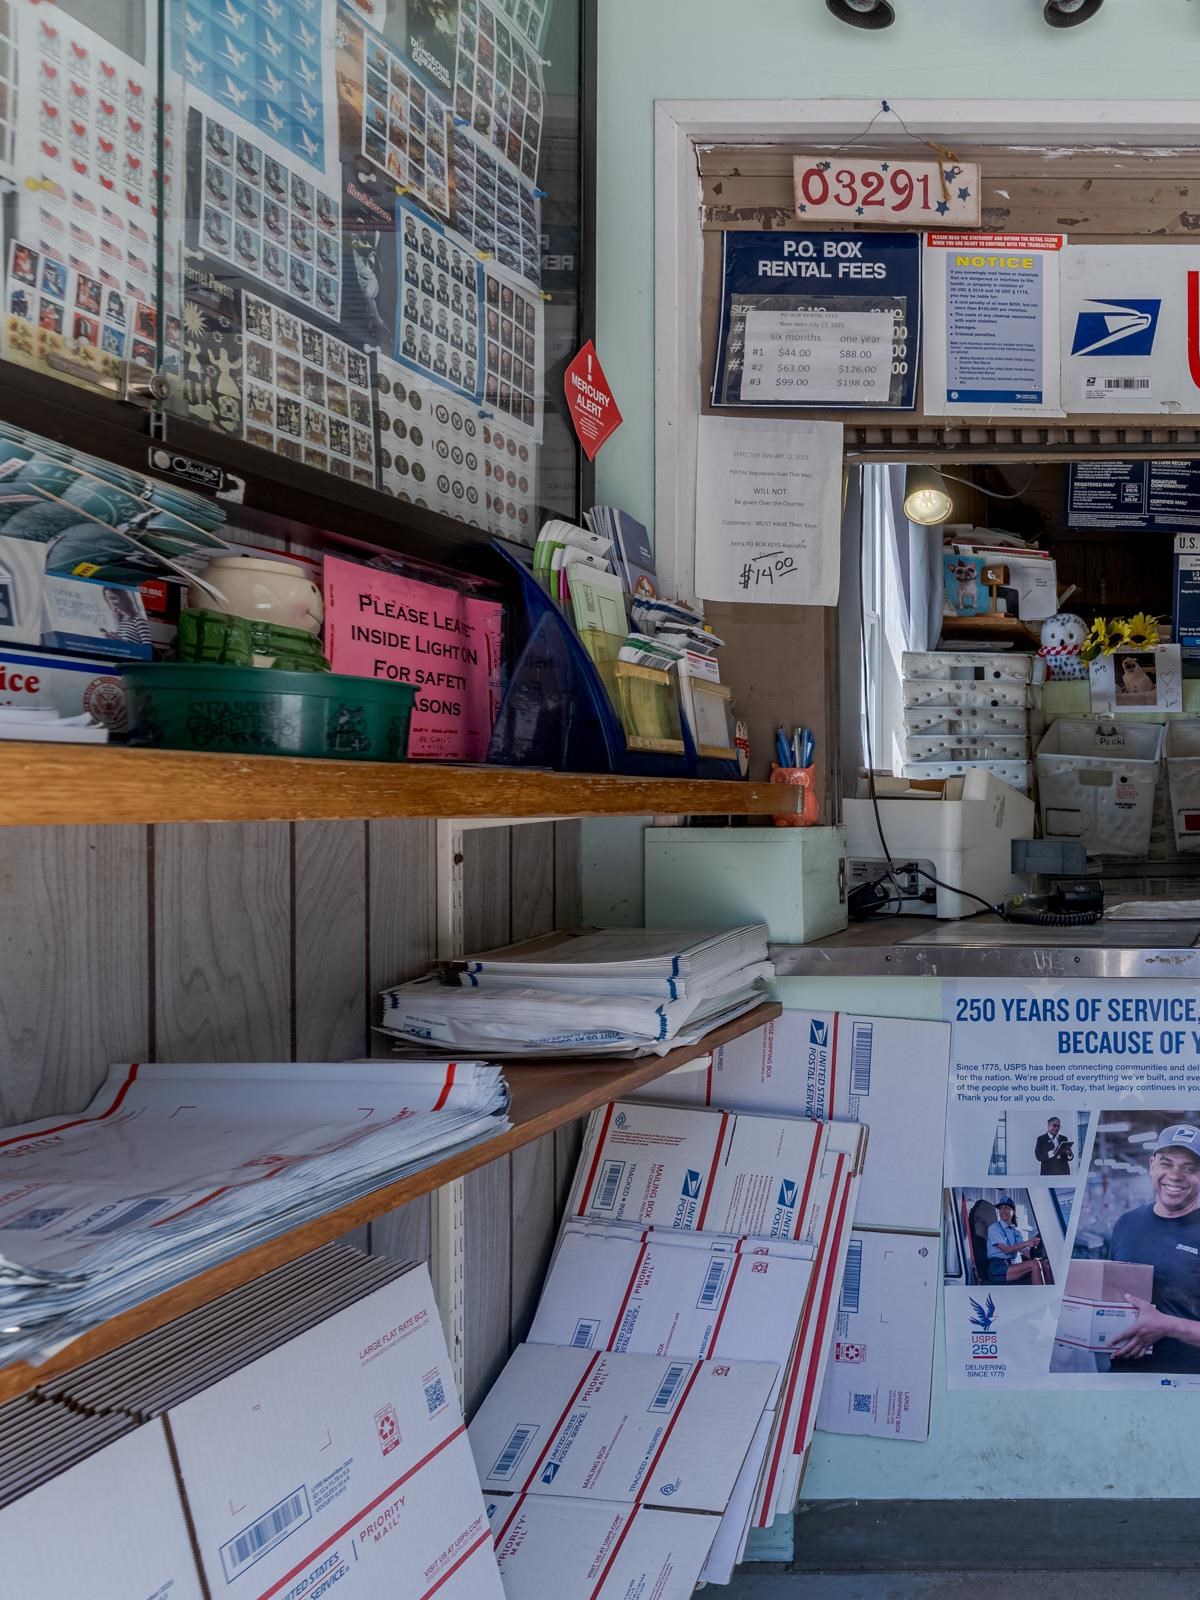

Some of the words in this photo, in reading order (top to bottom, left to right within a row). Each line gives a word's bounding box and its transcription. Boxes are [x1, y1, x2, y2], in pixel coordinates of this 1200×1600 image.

[801, 168, 932, 211] 03291
[784, 241, 817, 257] P.O.
[823, 241, 863, 258] BOX
[955, 255, 1034, 269] NOTICE
[758, 261, 832, 278] RENTAL
[838, 262, 887, 279] FEES
[785, 334, 822, 342] months
[860, 336, 881, 344] year
[752, 349, 764, 357] #1
[778, 349, 811, 358] $44.00
[839, 350, 872, 359] $88.00
[751, 364, 763, 372] #2
[777, 364, 810, 373] $63.00
[838, 365, 876, 374] $126.00
[571, 372, 611, 408] MERCURY
[750, 378, 761, 386] #3
[775, 378, 808, 387] $99.00
[836, 379, 875, 387] $198.00
[576, 393, 603, 419] ALERT
[753, 487, 770, 495] WILL
[1179, 537, 1198, 549] U.S.
[359, 593, 429, 626] PLEASE
[352, 625, 411, 650] INSIDE
[416, 635, 459, 660] LIGHT
[461, 649, 478, 666] ON
[374, 659, 410, 682] FOR
[415, 669, 467, 691] SAFETY
[956, 998, 996, 1022] 250
[1001, 998, 1070, 1022] YEARS
[1075, 998, 1102, 1022] OF
[1057, 1031, 1153, 1055] BECAUSE
[1159, 1032, 1186, 1055] OF
[808, 1047, 816, 1081] POSTAL
[817, 1050, 826, 1085] UNITED
[805, 1084, 814, 1118] SERVIC
[816, 1085, 825, 1119] STATES
[622, 1164, 637, 1196] TRACKED
[650, 1164, 664, 1198] MAILING
[645, 1200, 655, 1218] BOX
[359, 1339, 382, 1359] LARGE
[382, 1328, 397, 1343] FLAT
[399, 1317, 414, 1333] RATE
[414, 1309, 427, 1322] BOX
[971, 1335, 998, 1344] USPS
[972, 1344, 998, 1355] 250
[359, 1496, 406, 1544] PRIORITY
[374, 1514, 401, 1543] MAIL
